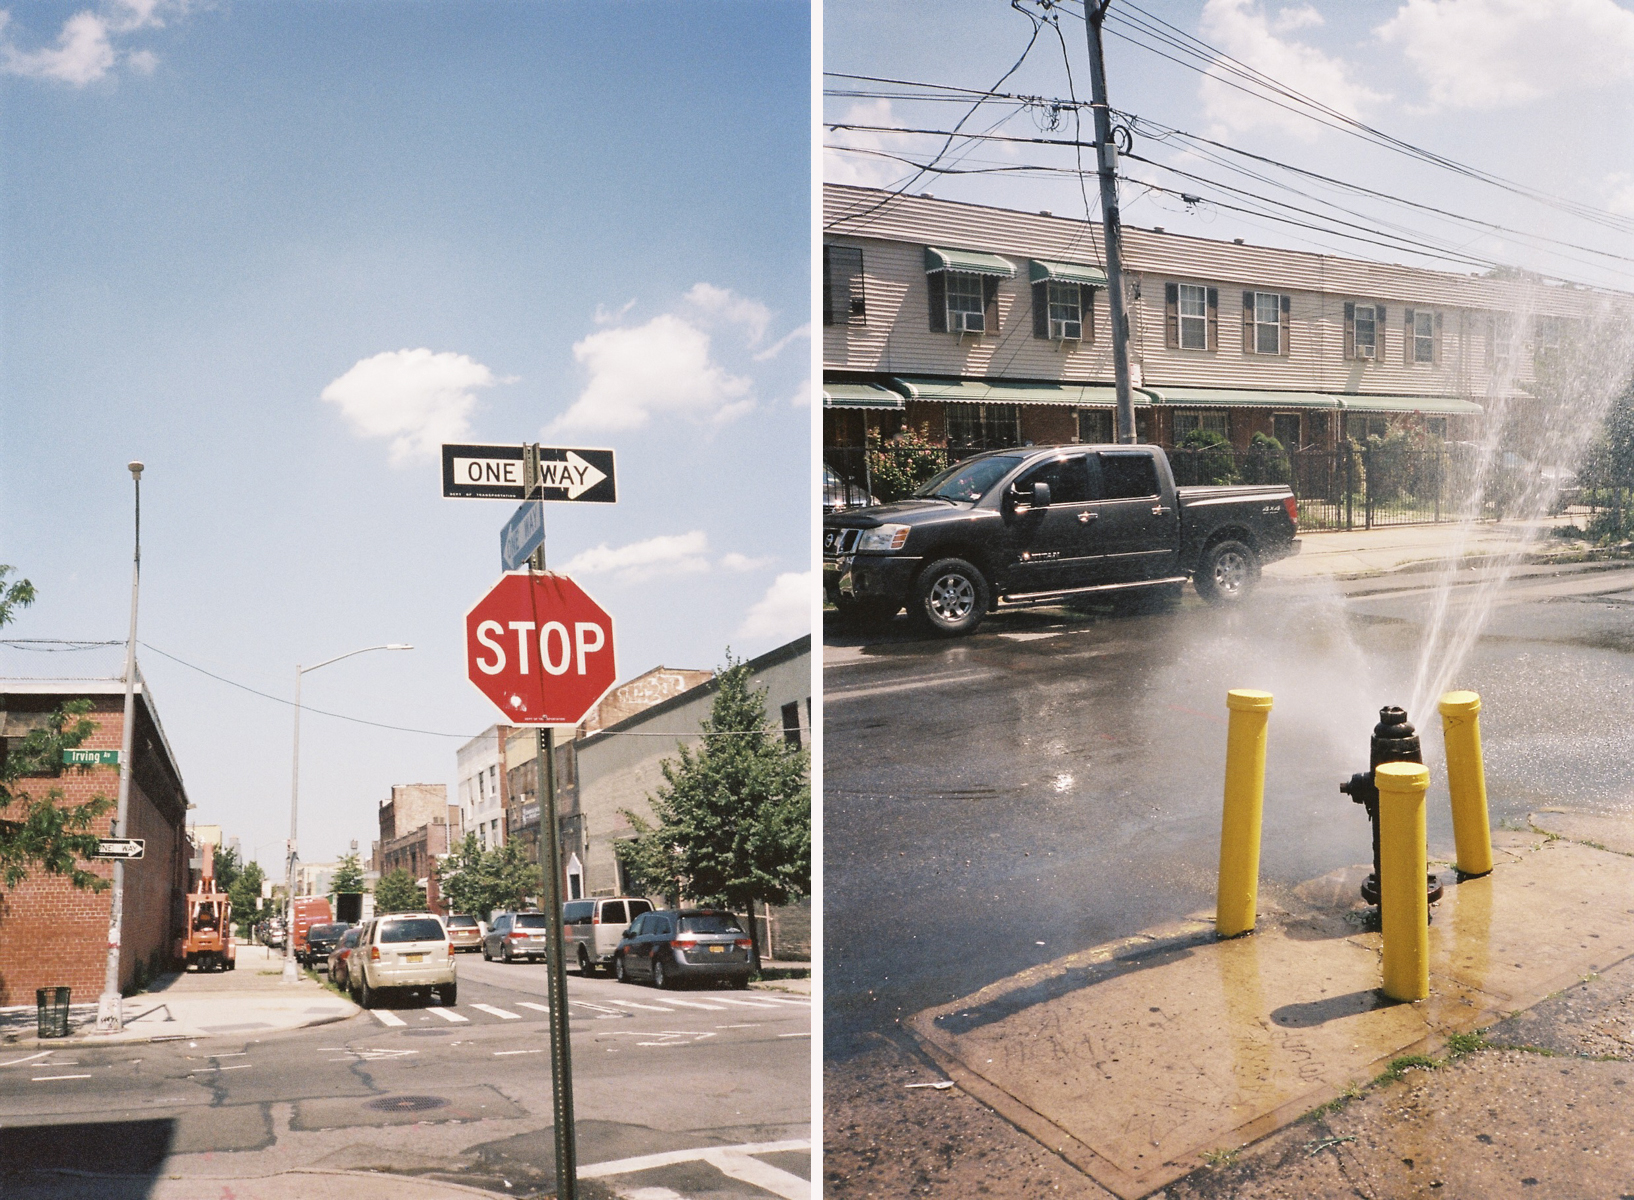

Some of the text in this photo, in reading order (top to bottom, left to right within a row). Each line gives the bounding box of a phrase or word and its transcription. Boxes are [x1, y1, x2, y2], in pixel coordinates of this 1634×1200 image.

[468, 461, 589, 486] ONE WAY
[476, 620, 605, 676] STOP
[72, 751, 100, 763] Irving
[122, 844, 138, 852] WAY
